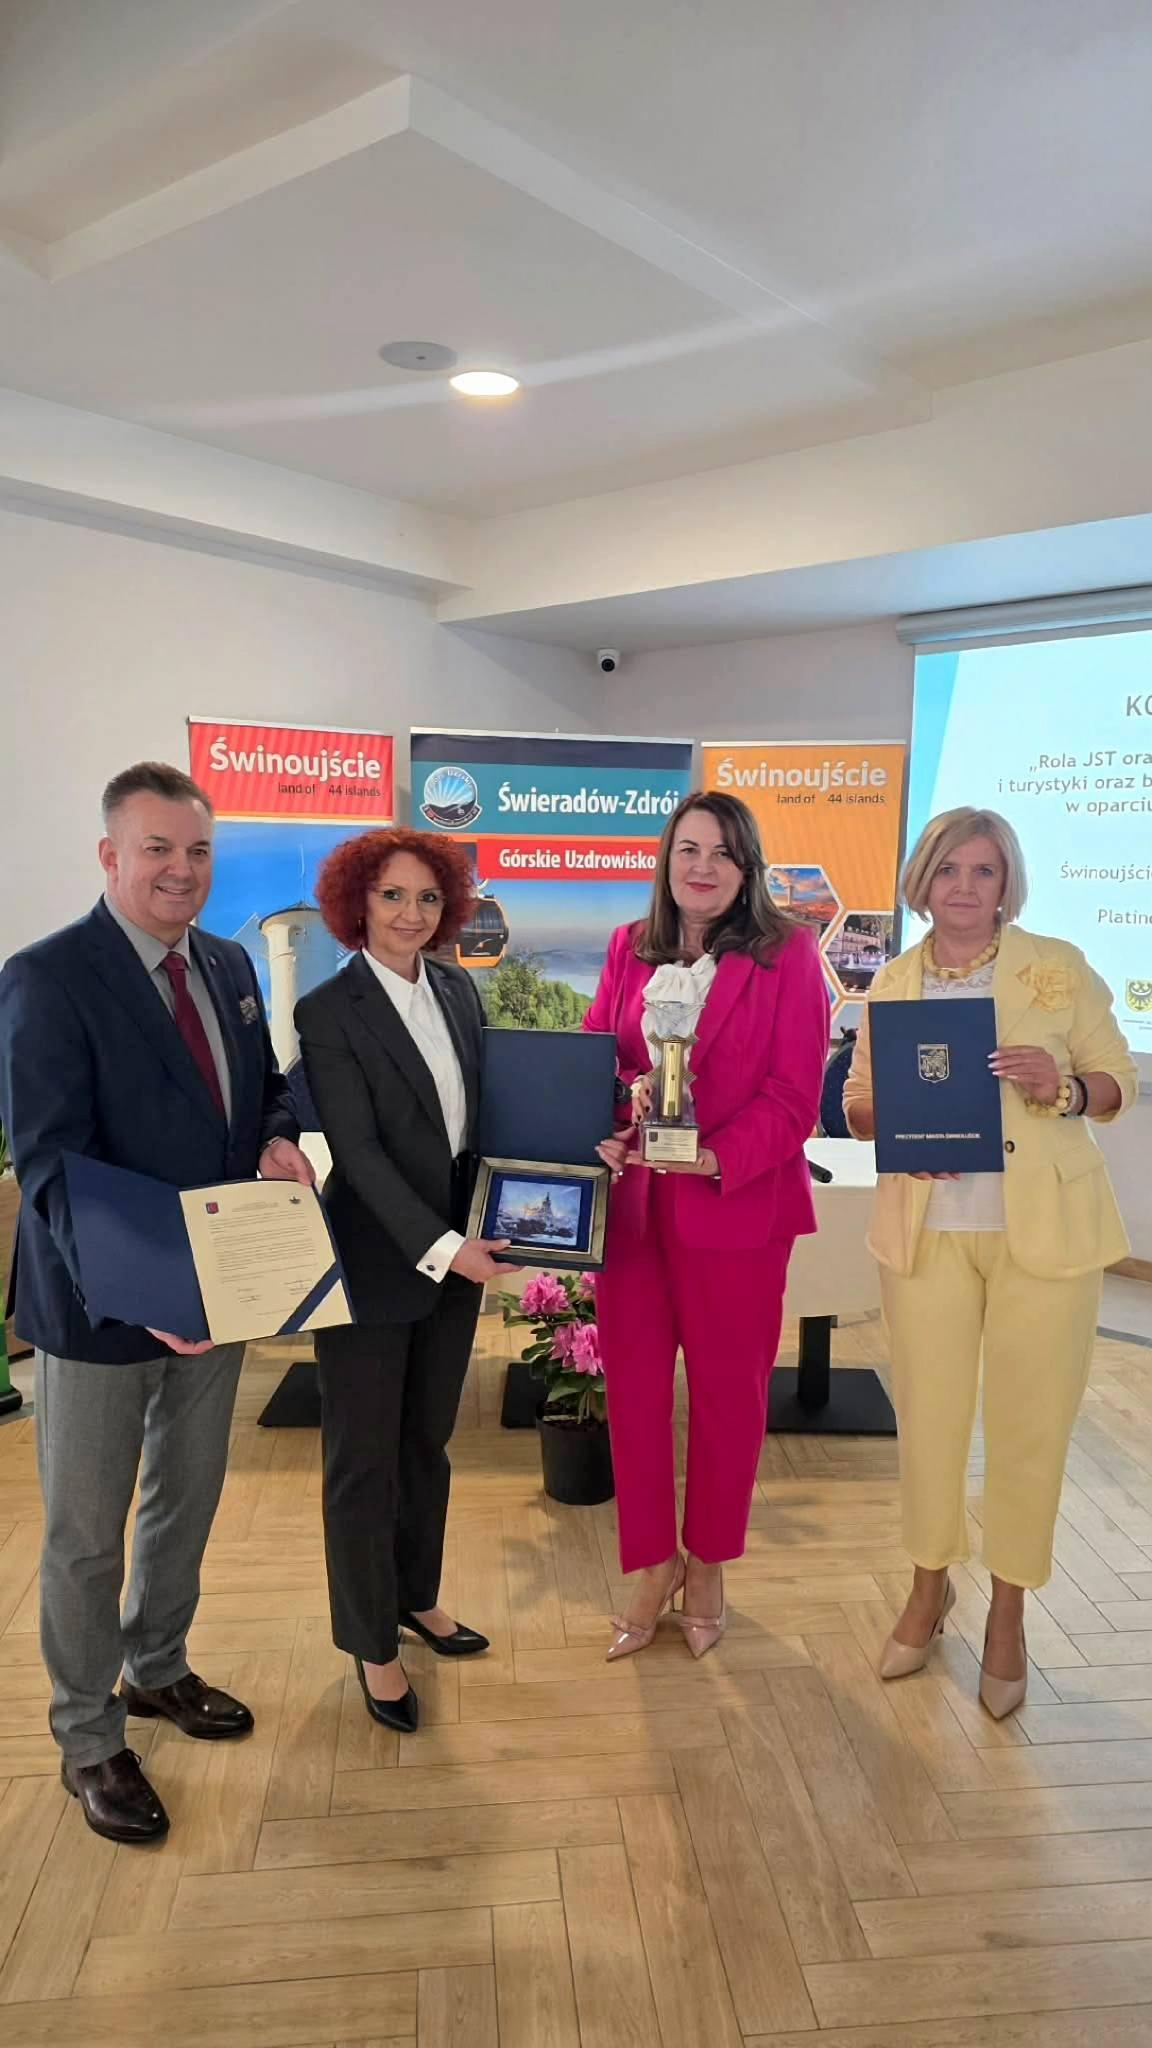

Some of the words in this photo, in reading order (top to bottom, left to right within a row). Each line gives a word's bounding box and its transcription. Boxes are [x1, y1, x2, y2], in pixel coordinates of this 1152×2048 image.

[210, 736, 382, 782] Świnoujście
[1083, 751, 1118, 767] JST
[717, 758, 887, 792] Świnoujście
[278, 782, 303, 795] land
[304, 783, 316, 795] of
[328, 784, 343, 796] 44
[345, 784, 381, 797] islands
[998, 779, 1003, 793] i
[1009, 776, 1088, 795] turystyki
[1094, 777, 1135, 790] oraz
[777, 793, 801, 804] land
[803, 793, 816, 804] of
[827, 794, 842, 804] 44
[846, 793, 886, 804] islands
[1066, 801, 1080, 813] w
[499, 848, 561, 869] Górskie
[565, 850, 657, 870] Uzdrowisko
[1060, 861, 1152, 883] Świnoujści
